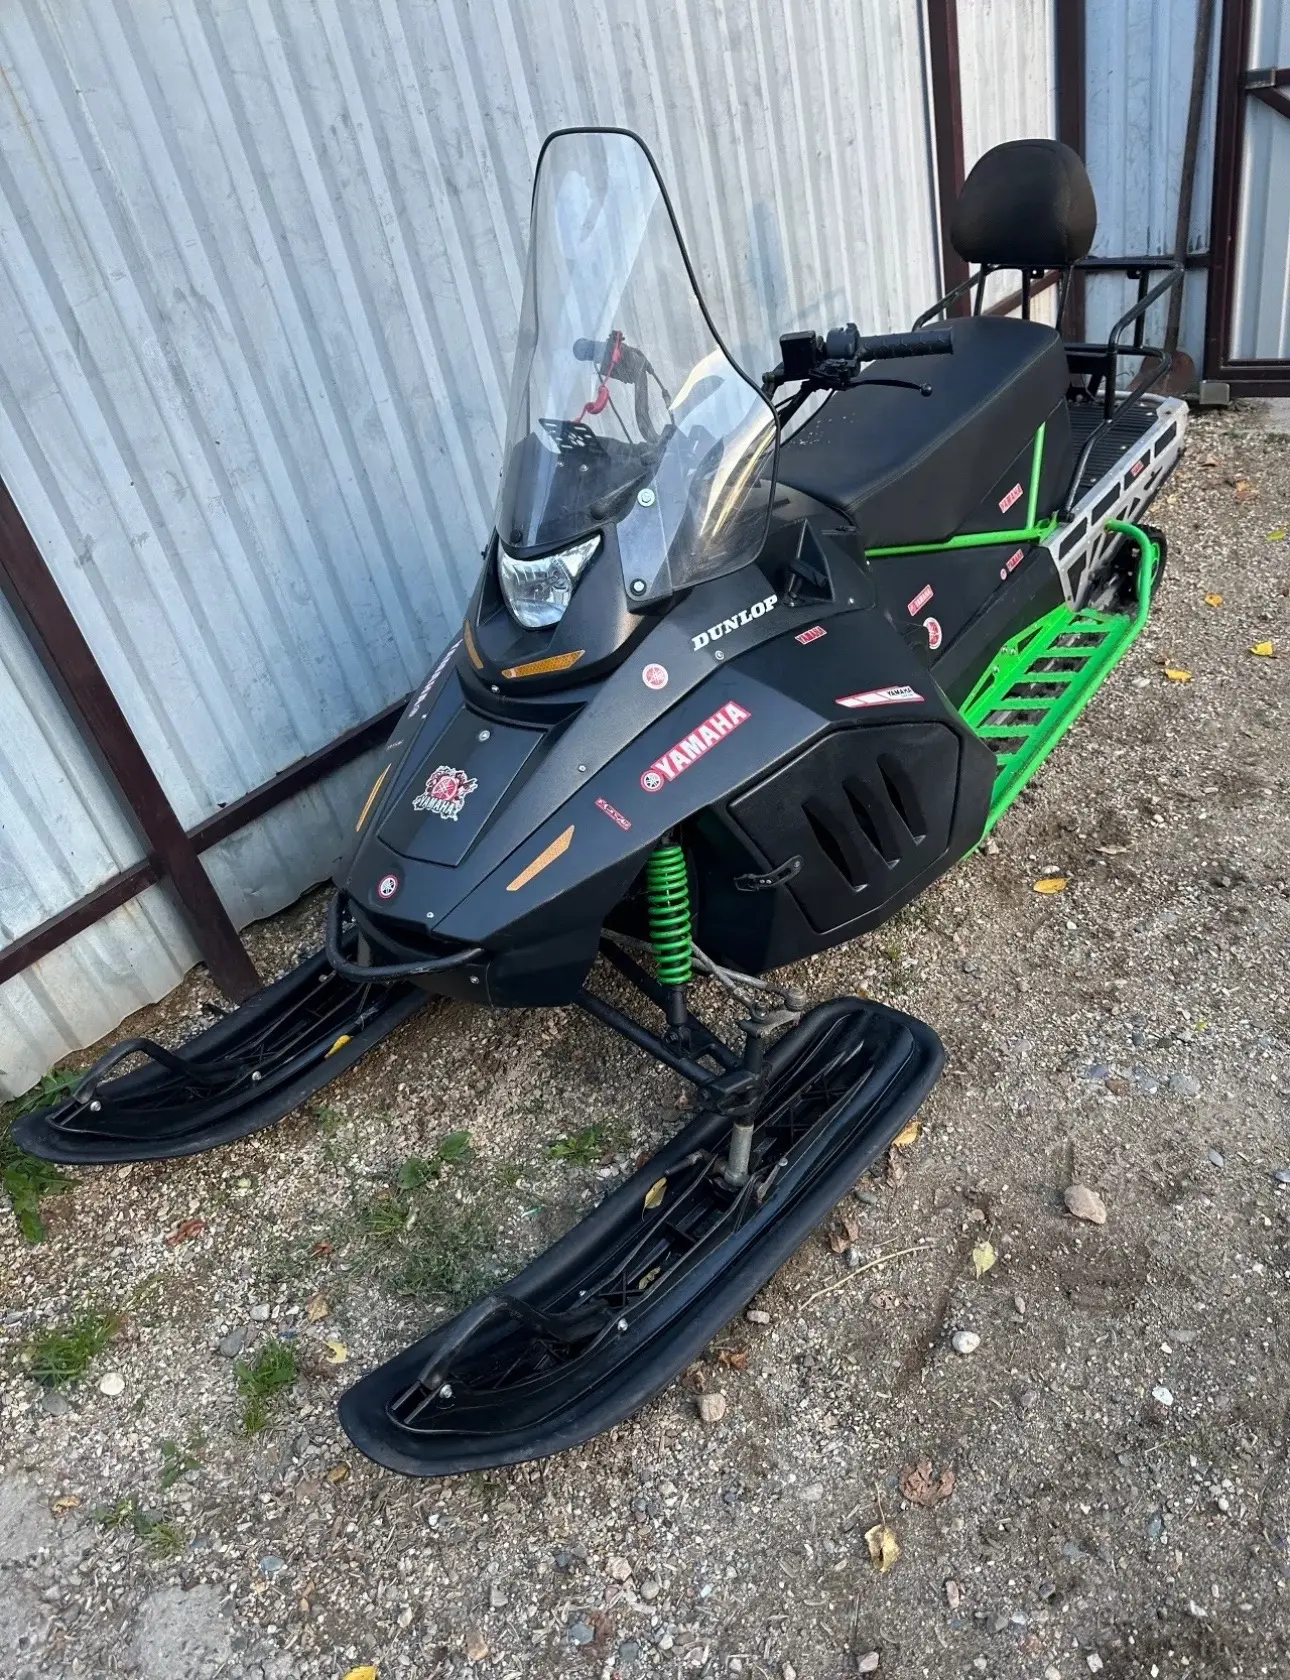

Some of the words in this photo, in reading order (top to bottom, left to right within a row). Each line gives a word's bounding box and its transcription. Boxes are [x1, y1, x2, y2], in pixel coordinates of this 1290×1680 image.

[691, 595, 778, 651] DUNLOP
[888, 687, 912, 697] YAMAHA
[655, 702, 748, 780] YAMAHA
[418, 796, 455, 815] YAMAHA
